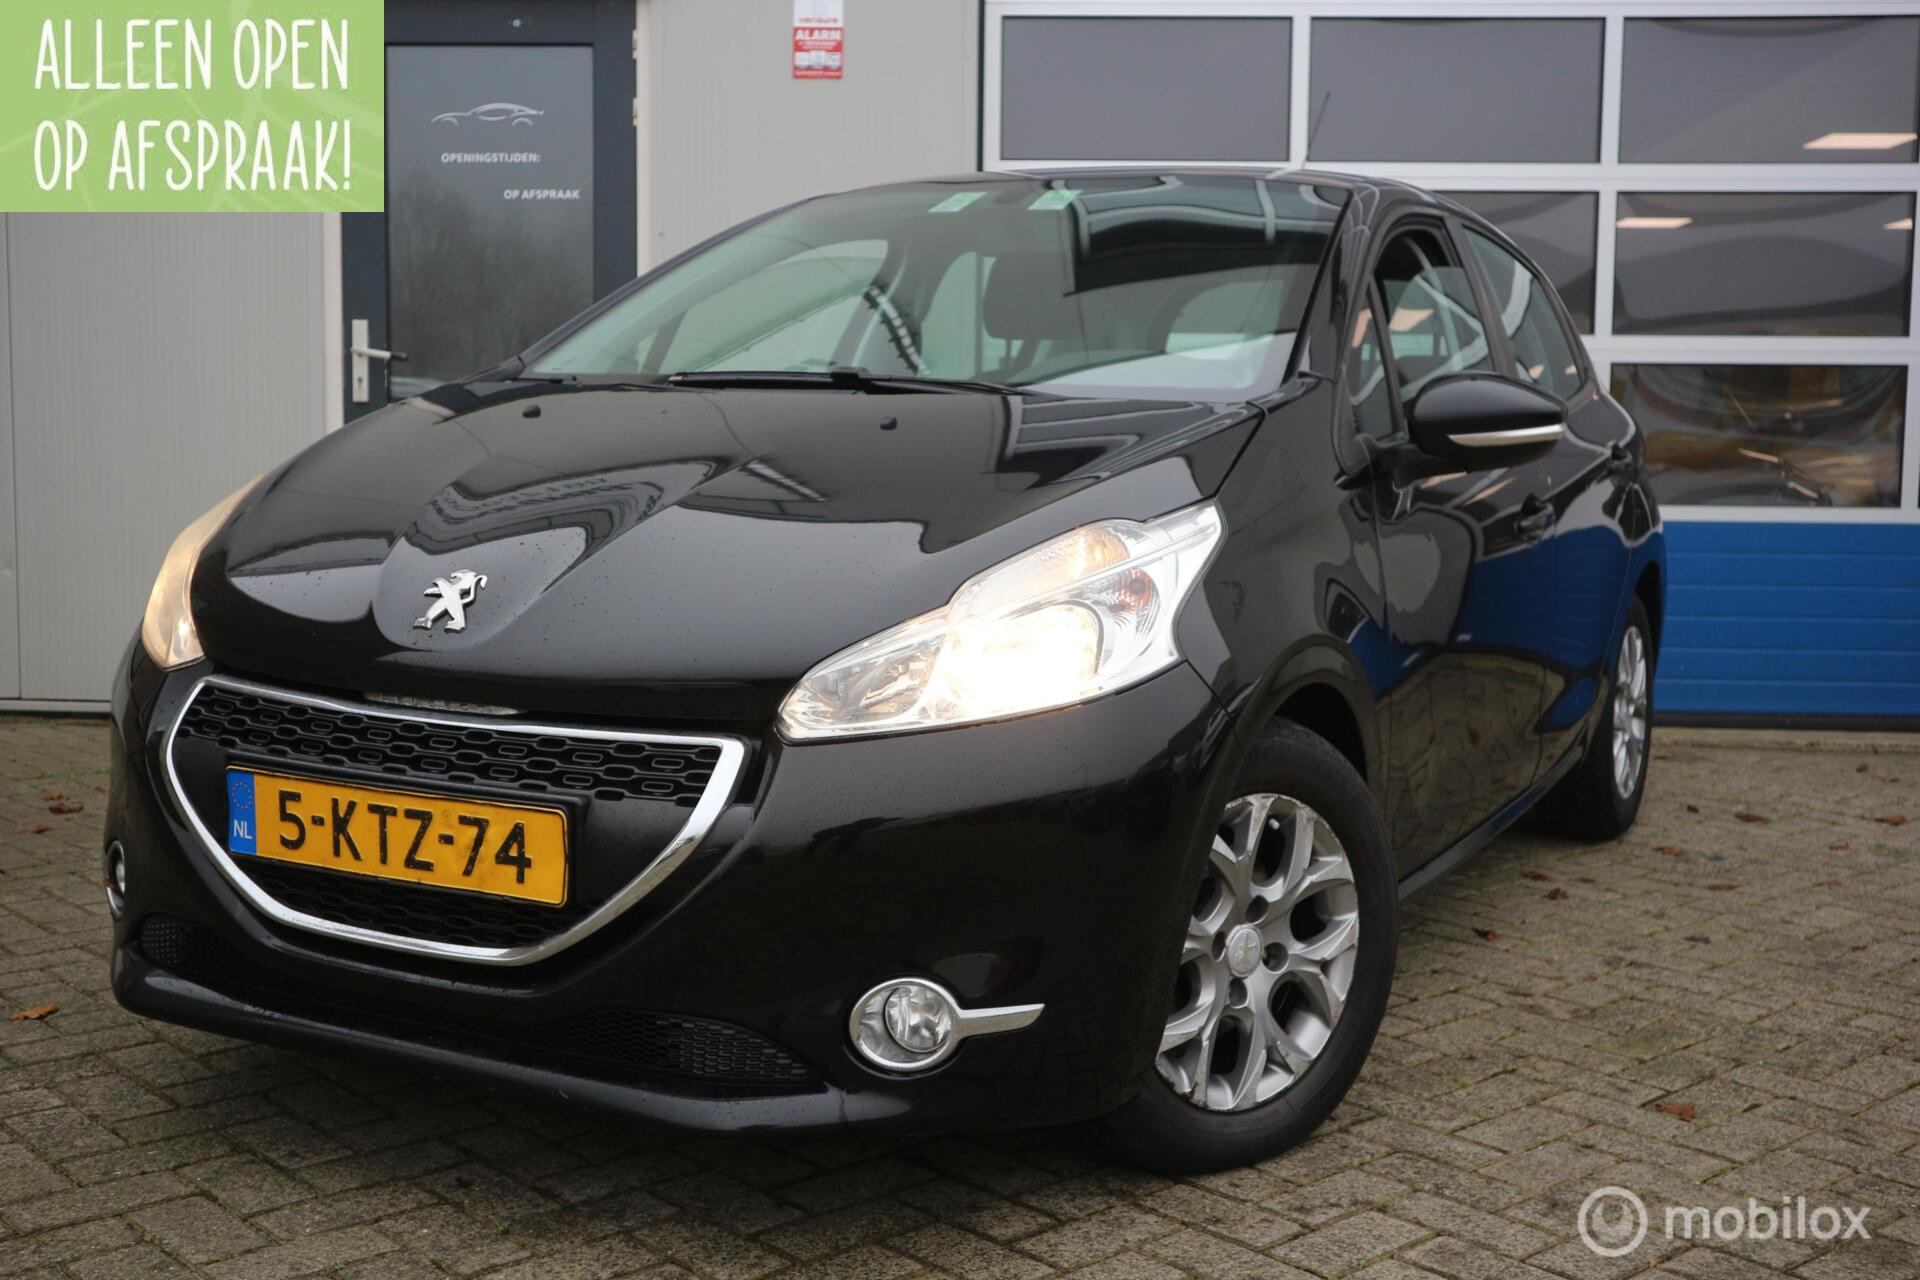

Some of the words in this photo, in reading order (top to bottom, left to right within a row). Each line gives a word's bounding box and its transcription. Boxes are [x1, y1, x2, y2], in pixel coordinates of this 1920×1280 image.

[441, 152, 541, 163] OPENINGSTIJDEN:
[504, 189, 520, 199] OP
[522, 189, 580, 199] AFSPRAAK
[233, 819, 253, 840] NL
[278, 789, 532, 884] 5-KTZ-74
